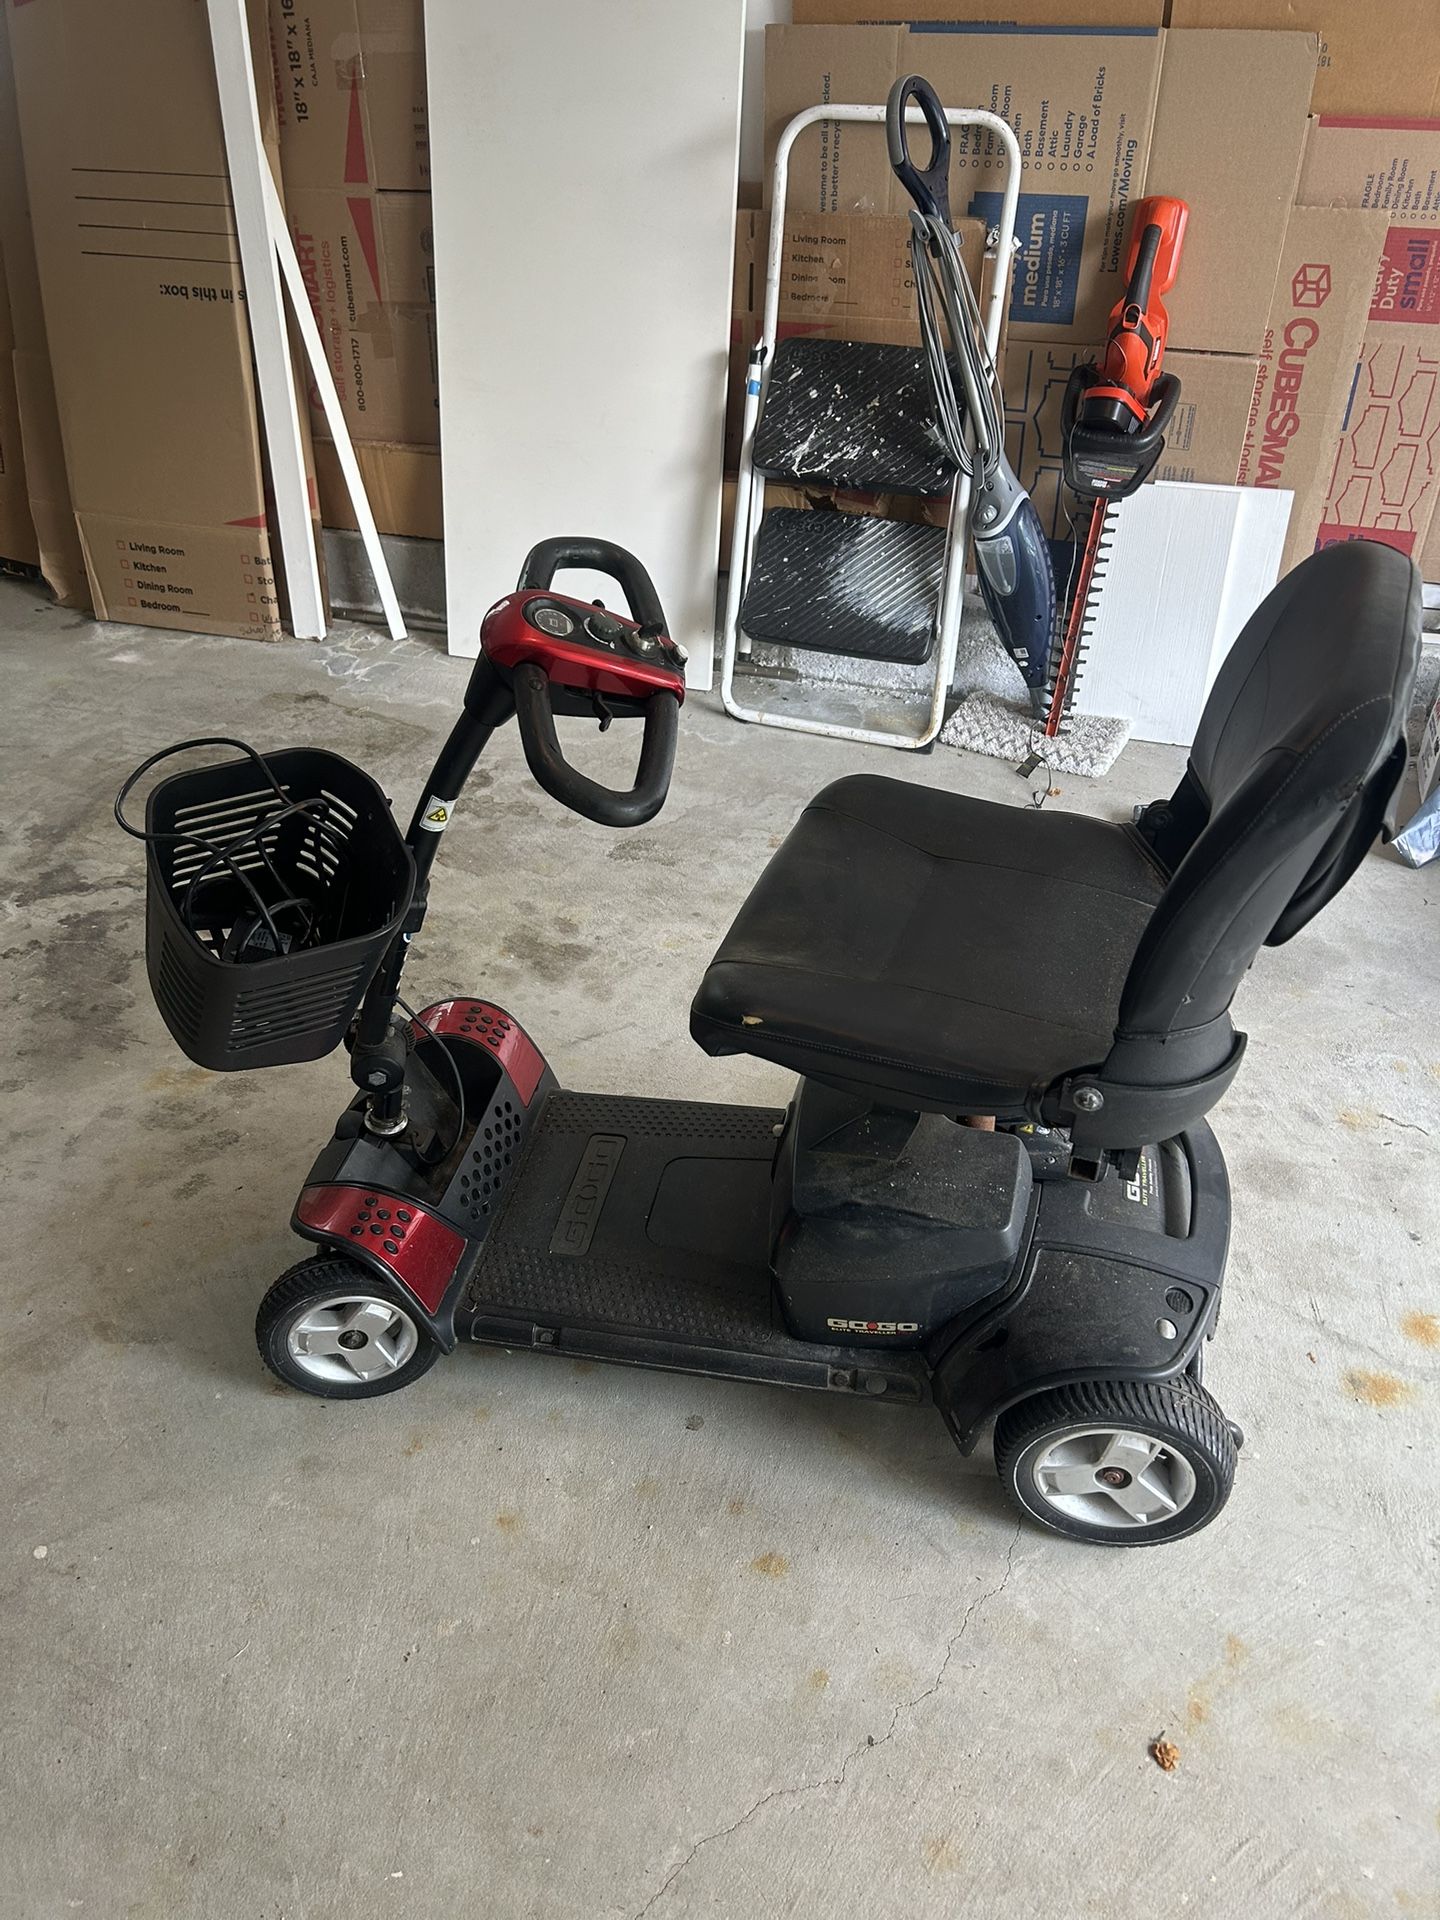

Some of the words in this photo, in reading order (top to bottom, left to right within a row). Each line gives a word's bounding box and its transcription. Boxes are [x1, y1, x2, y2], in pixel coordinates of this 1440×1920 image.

[287, 25, 298, 36] x
[304, 18, 315, 61] MEDIANA
[294, 77, 305, 88] x
[310, 63, 319, 87] CAJA
[1093, 66, 1106, 103] Bricks
[822, 72, 831, 129] ucked.
[1001, 85, 1012, 117] Room
[1092, 104, 1101, 117] of
[821, 131, 829, 144] all
[960, 106, 972, 155] FRAG
[1035, 99, 1050, 157] Basement
[1060, 110, 1076, 159] Laundry
[1073, 115, 1088, 158] Garage
[1088, 119, 1100, 148] Load
[820, 145, 829, 157] be
[832, 152, 840, 163] to
[1022, 130, 1033, 157] Bath
[1048, 130, 1059, 158] Attic
[1086, 150, 1095, 159] A
[1110, 178, 1118, 199] move
[1118, 113, 1126, 130] visit
[830, 165, 840, 195] better
[1387, 158, 1399, 182] Room
[1397, 158, 1409, 182] Room
[1361, 173, 1376, 209] FRAGILE
[1371, 171, 1386, 209] Bedroom
[1381, 182, 1395, 209] Family
[1391, 184, 1405, 210] Dining
[1401, 178, 1415, 210] Kitchen
[1411, 190, 1422, 211] Bath
[1421, 170, 1438, 211] Basement
[1062, 211, 1071, 224] FT
[1107, 139, 1138, 273] Lowes.com/Moving
[792, 235, 819, 246] Living
[821, 236, 847, 245] Room
[1049, 209, 1059, 244] mediana
[1061, 225, 1070, 240] CU
[319, 240, 337, 303] logistics
[791, 254, 825, 264] Kitchen
[1023, 213, 1046, 306] medium
[341, 235, 357, 323] cubesmart.com
[1400, 239, 1431, 309] small
[160, 284, 190, 300] box:
[192, 287, 218, 302] this
[220, 289, 234, 303] in
[1379, 267, 1405, 310] Duty
[328, 318, 346, 373] storage
[350, 338, 367, 412] 800-800-1717
[1254, 317, 1320, 489] CUBESMA
[129, 542, 157, 555] Living
[158, 545, 185, 557] Room
[132, 561, 167, 574] Kitchen
[137, 580, 166, 594] Dining
[167, 584, 194, 596] Room
[140, 599, 181, 613] Bedroom
